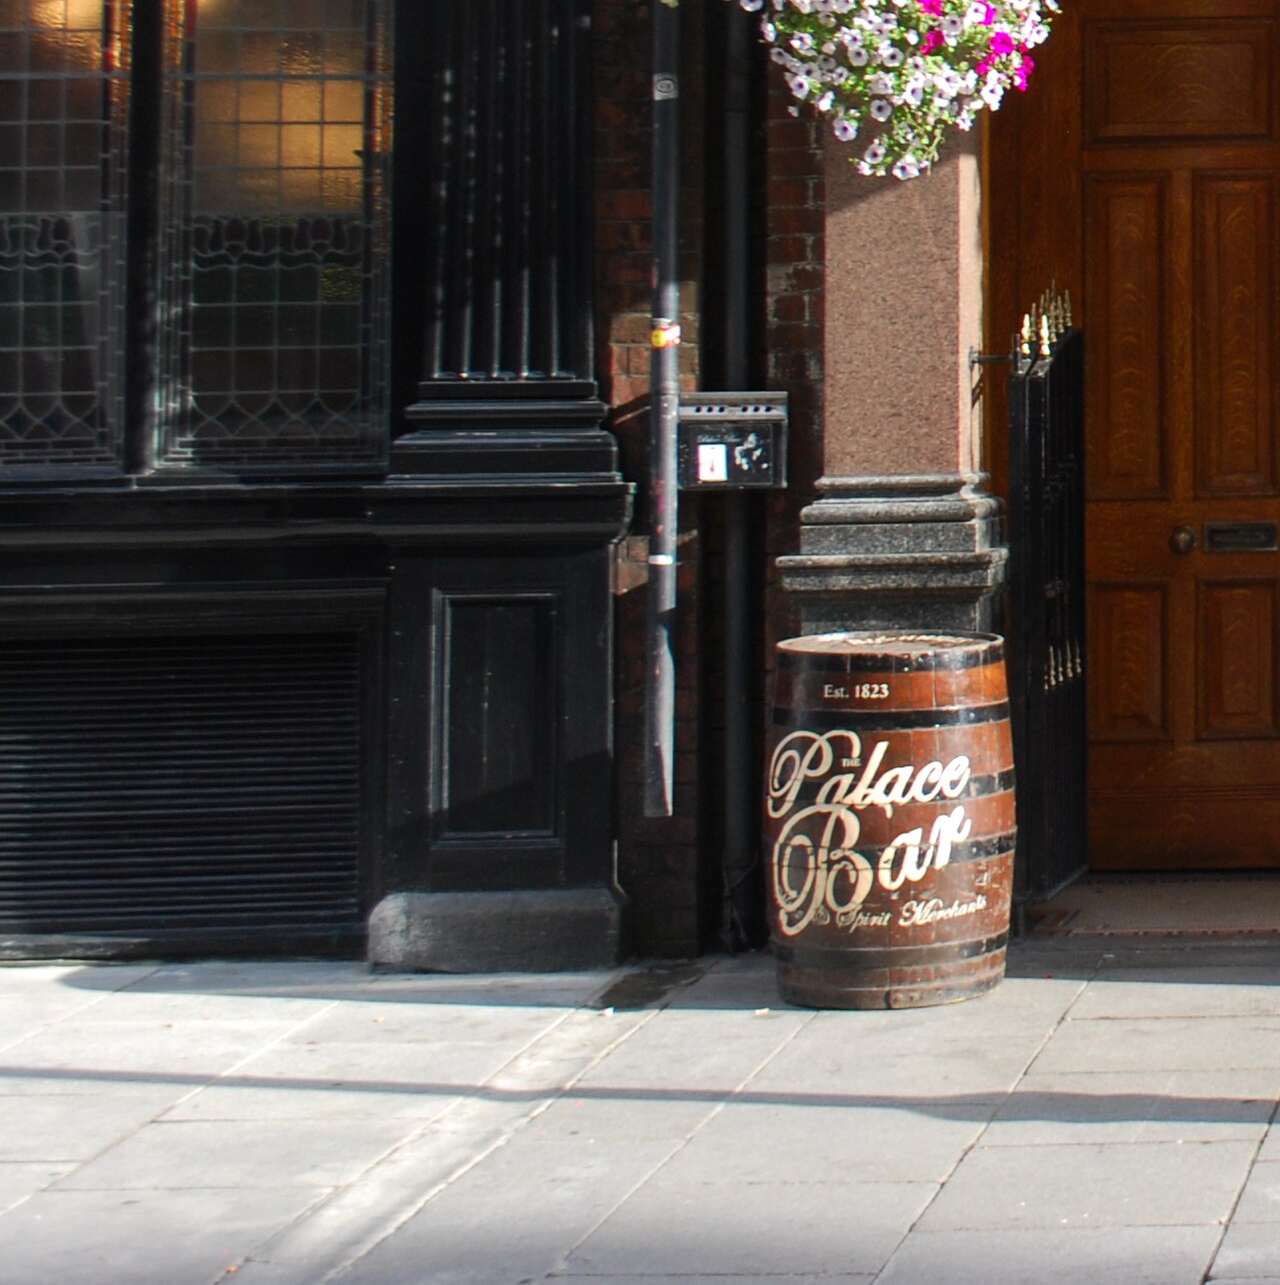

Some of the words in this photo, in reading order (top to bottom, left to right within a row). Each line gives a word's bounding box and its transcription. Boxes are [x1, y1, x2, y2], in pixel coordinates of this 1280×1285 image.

[823, 683, 849, 699] Est.
[854, 683, 890, 699] 1823
[768, 729, 971, 819] Palace
[773, 804, 972, 936] Bar
[836, 905, 891, 933] Spirit
[899, 894, 987, 926] Merchants
